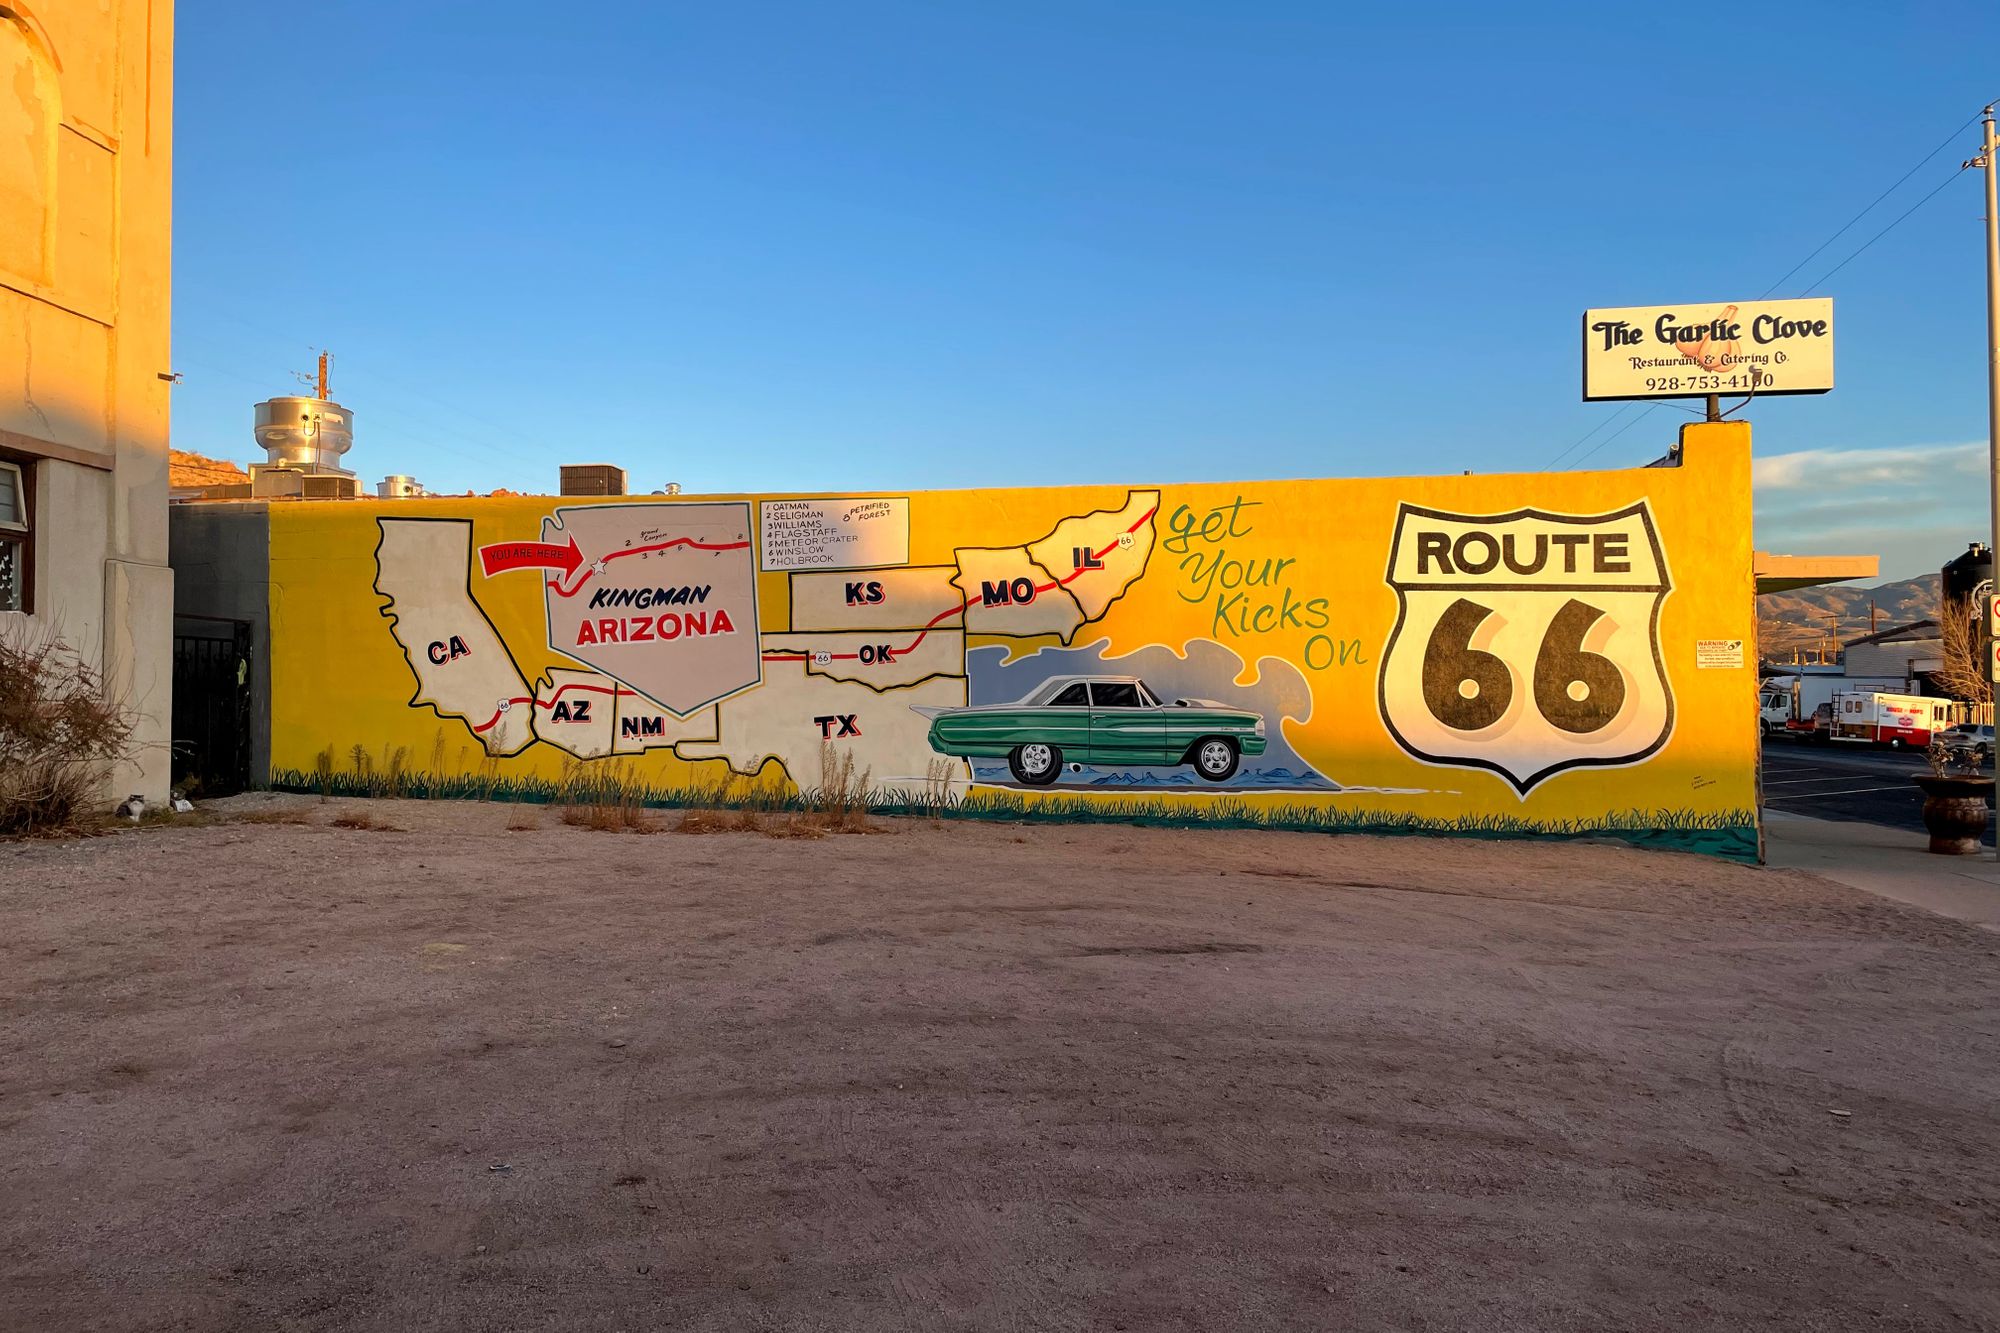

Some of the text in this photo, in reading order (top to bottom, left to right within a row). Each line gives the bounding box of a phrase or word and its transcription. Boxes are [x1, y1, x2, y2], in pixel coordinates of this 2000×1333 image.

[1592, 313, 1828, 351] The Garlic Clove
[1704, 354, 1715, 365] &
[1721, 352, 1769, 366] Catering
[1774, 351, 1790, 364] Co.
[773, 503, 810, 511] OATMAN
[773, 511, 824, 521] SELIGMAN
[843, 502, 890, 522] 8 PETRIFIED
[858, 509, 892, 521] FOREST
[774, 520, 823, 530] WILLIAMS
[774, 528, 837, 539] FLAGSTAFF
[1163, 495, 1264, 554] get
[625, 539, 632, 547] 2
[774, 538, 819, 548] METEOR
[821, 535, 858, 545] CRATER
[1121, 536, 1131, 544] 66
[490, 550, 511, 561] YOU
[513, 548, 533, 558] ARE
[536, 550, 564, 559] HERE
[642, 552, 649, 560] 3
[658, 550, 666, 558] 4
[769, 555, 834, 566] 7 HOLBROOK
[775, 546, 824, 557] WINSLOW
[1073, 547, 1104, 570] IL
[1417, 531, 1632, 576] ROUTE
[1177, 549, 1297, 604] Your
[588, 584, 712, 610] KINGMAN
[845, 581, 886, 605] KS
[981, 577, 1036, 608] MO
[1212, 587, 1330, 639] Kicks
[576, 609, 736, 647] ARIZONA
[427, 635, 471, 666] CA
[818, 654, 829, 662] 66
[859, 645, 896, 665] OK
[1304, 634, 1369, 671] On
[1422, 598, 1626, 734] 66
[551, 700, 592, 724] AZ
[621, 716, 665, 737] NM
[814, 714, 862, 741] TX
